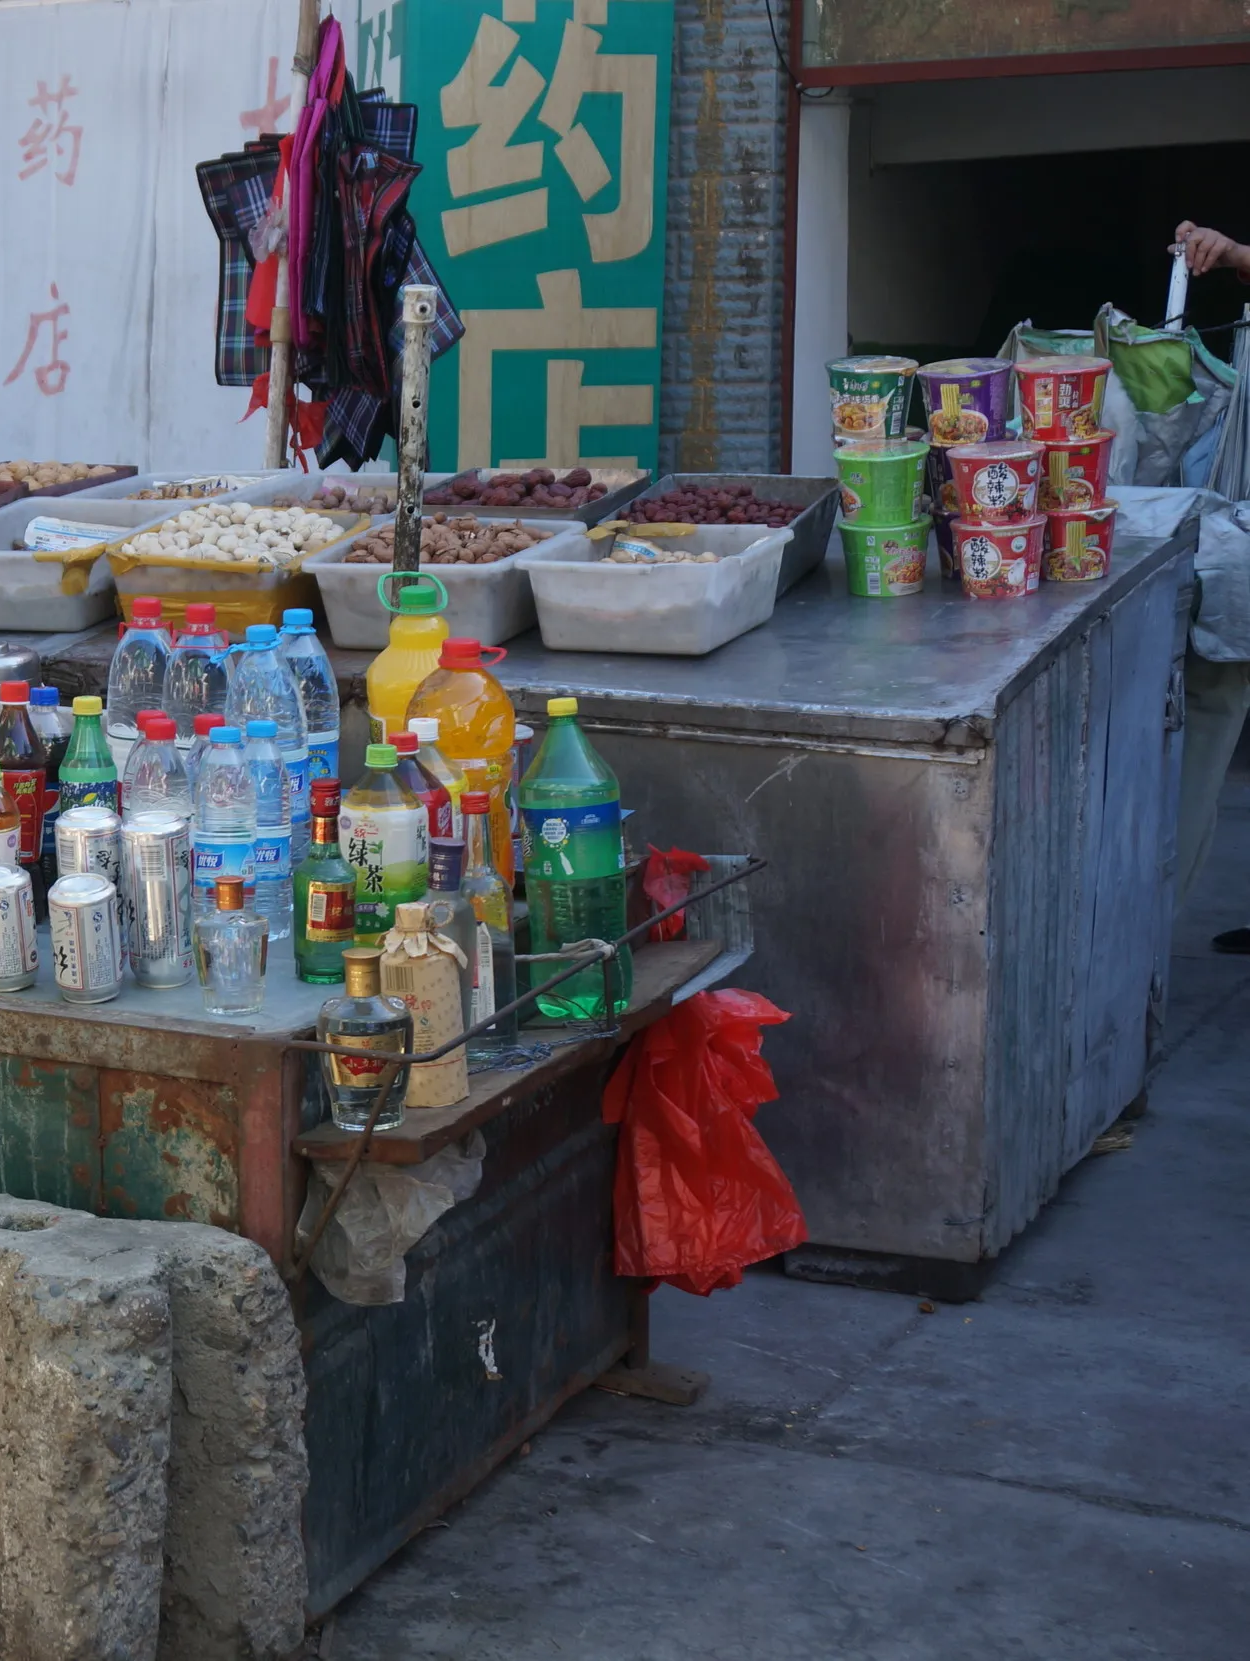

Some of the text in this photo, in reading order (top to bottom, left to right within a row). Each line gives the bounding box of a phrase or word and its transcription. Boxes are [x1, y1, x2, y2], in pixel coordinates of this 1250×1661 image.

[4, 74, 83, 396] 药店
[987, 462, 1008, 506] 酸辣粉
[971, 537, 990, 579] 酸辣粉
[348, 837, 384, 893] 绿茶
